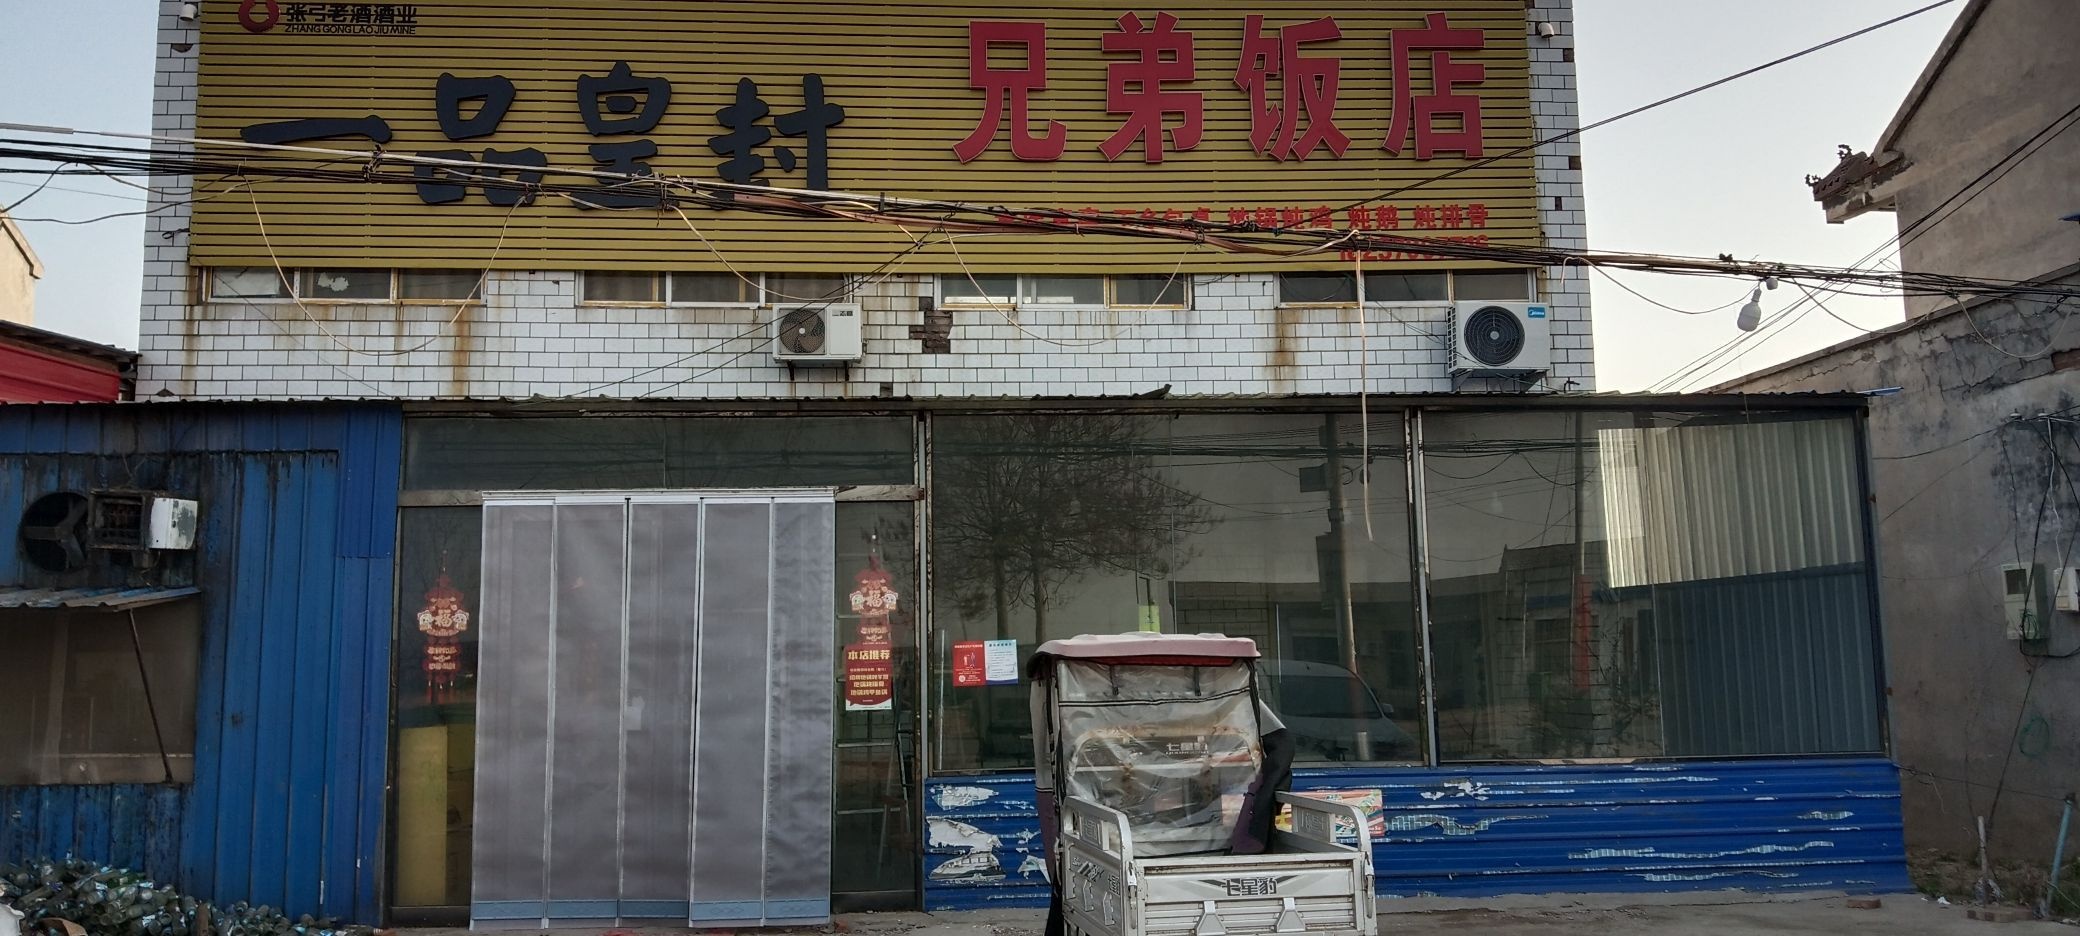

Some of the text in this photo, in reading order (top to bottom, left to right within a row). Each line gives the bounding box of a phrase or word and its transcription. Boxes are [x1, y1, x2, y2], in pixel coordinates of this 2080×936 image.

[287, 4, 417, 24] 张弓老酒酒业
[285, 24, 321, 33] ZHANG
[952, 11, 1487, 165] 兄弟饭店
[239, 60, 845, 210] 一品皇封
[1413, 203, 1488, 229] 炖排骨
[848, 649, 891, 660] 本店推荐
[1222, 877, 1278, 897] 七星豹
